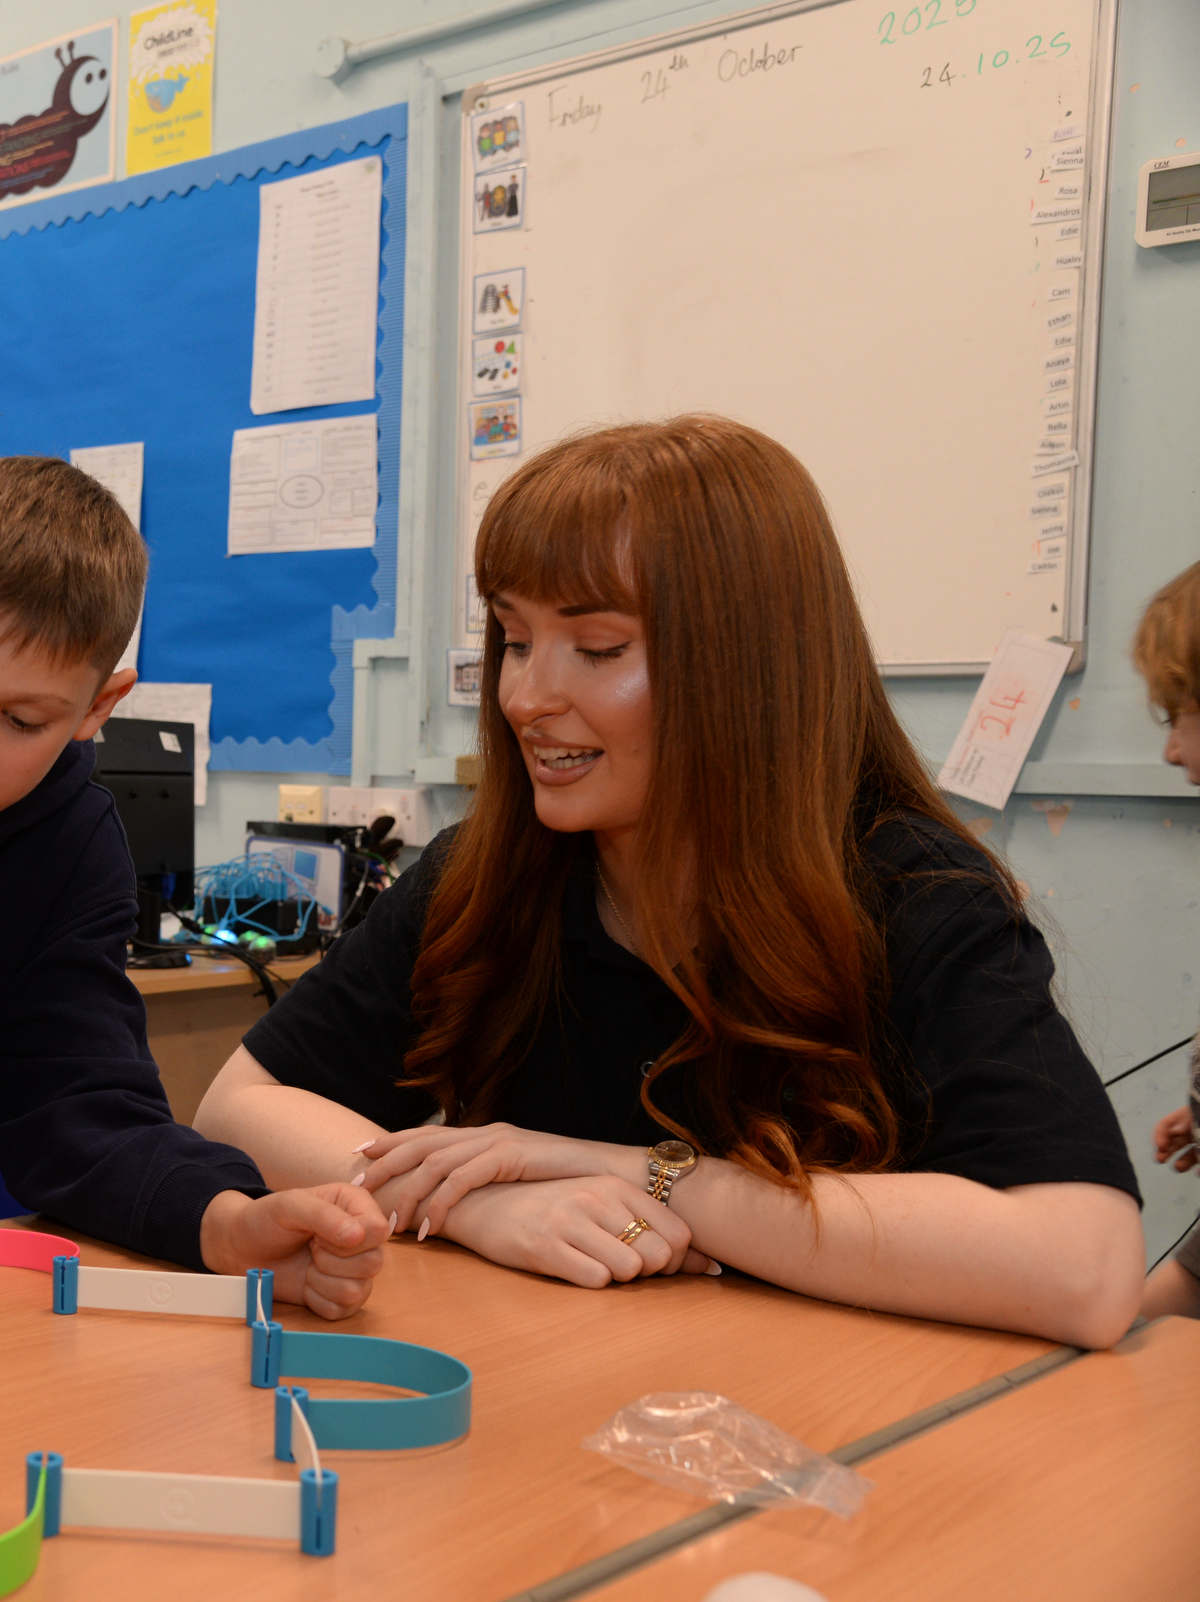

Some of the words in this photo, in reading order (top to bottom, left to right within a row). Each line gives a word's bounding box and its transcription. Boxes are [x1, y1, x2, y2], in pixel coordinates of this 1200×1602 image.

[548, 84, 603, 133] Friday
[718, 42, 803, 83] October
[1056, 156, 1084, 167] Sienna
